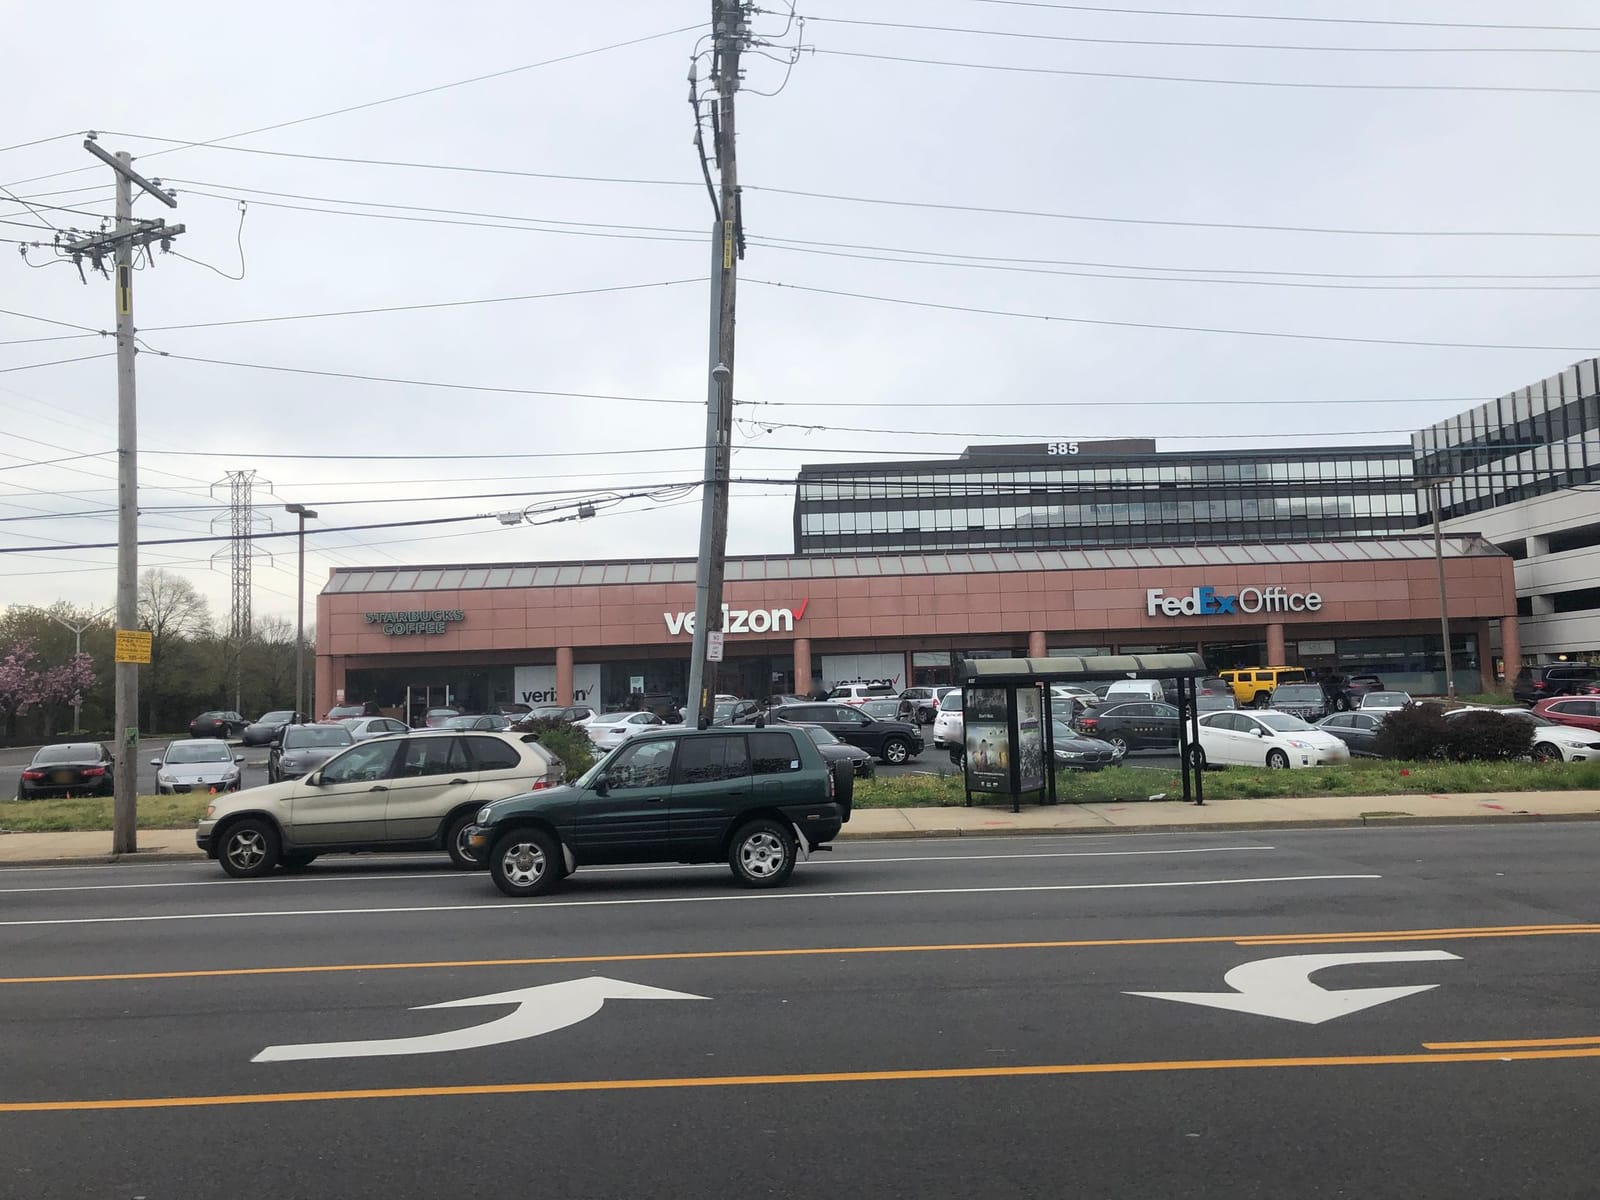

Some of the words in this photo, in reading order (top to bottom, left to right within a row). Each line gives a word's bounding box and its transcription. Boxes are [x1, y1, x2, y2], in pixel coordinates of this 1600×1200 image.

[1047, 441, 1079, 455] 585
[1146, 586, 1237, 617] FedEx
[1239, 586, 1322, 614] Office
[364, 609, 465, 624] STARBUCKS
[663, 603, 793, 634] veizon
[383, 621, 446, 636] COFFEE
[522, 687, 586, 703] verin
